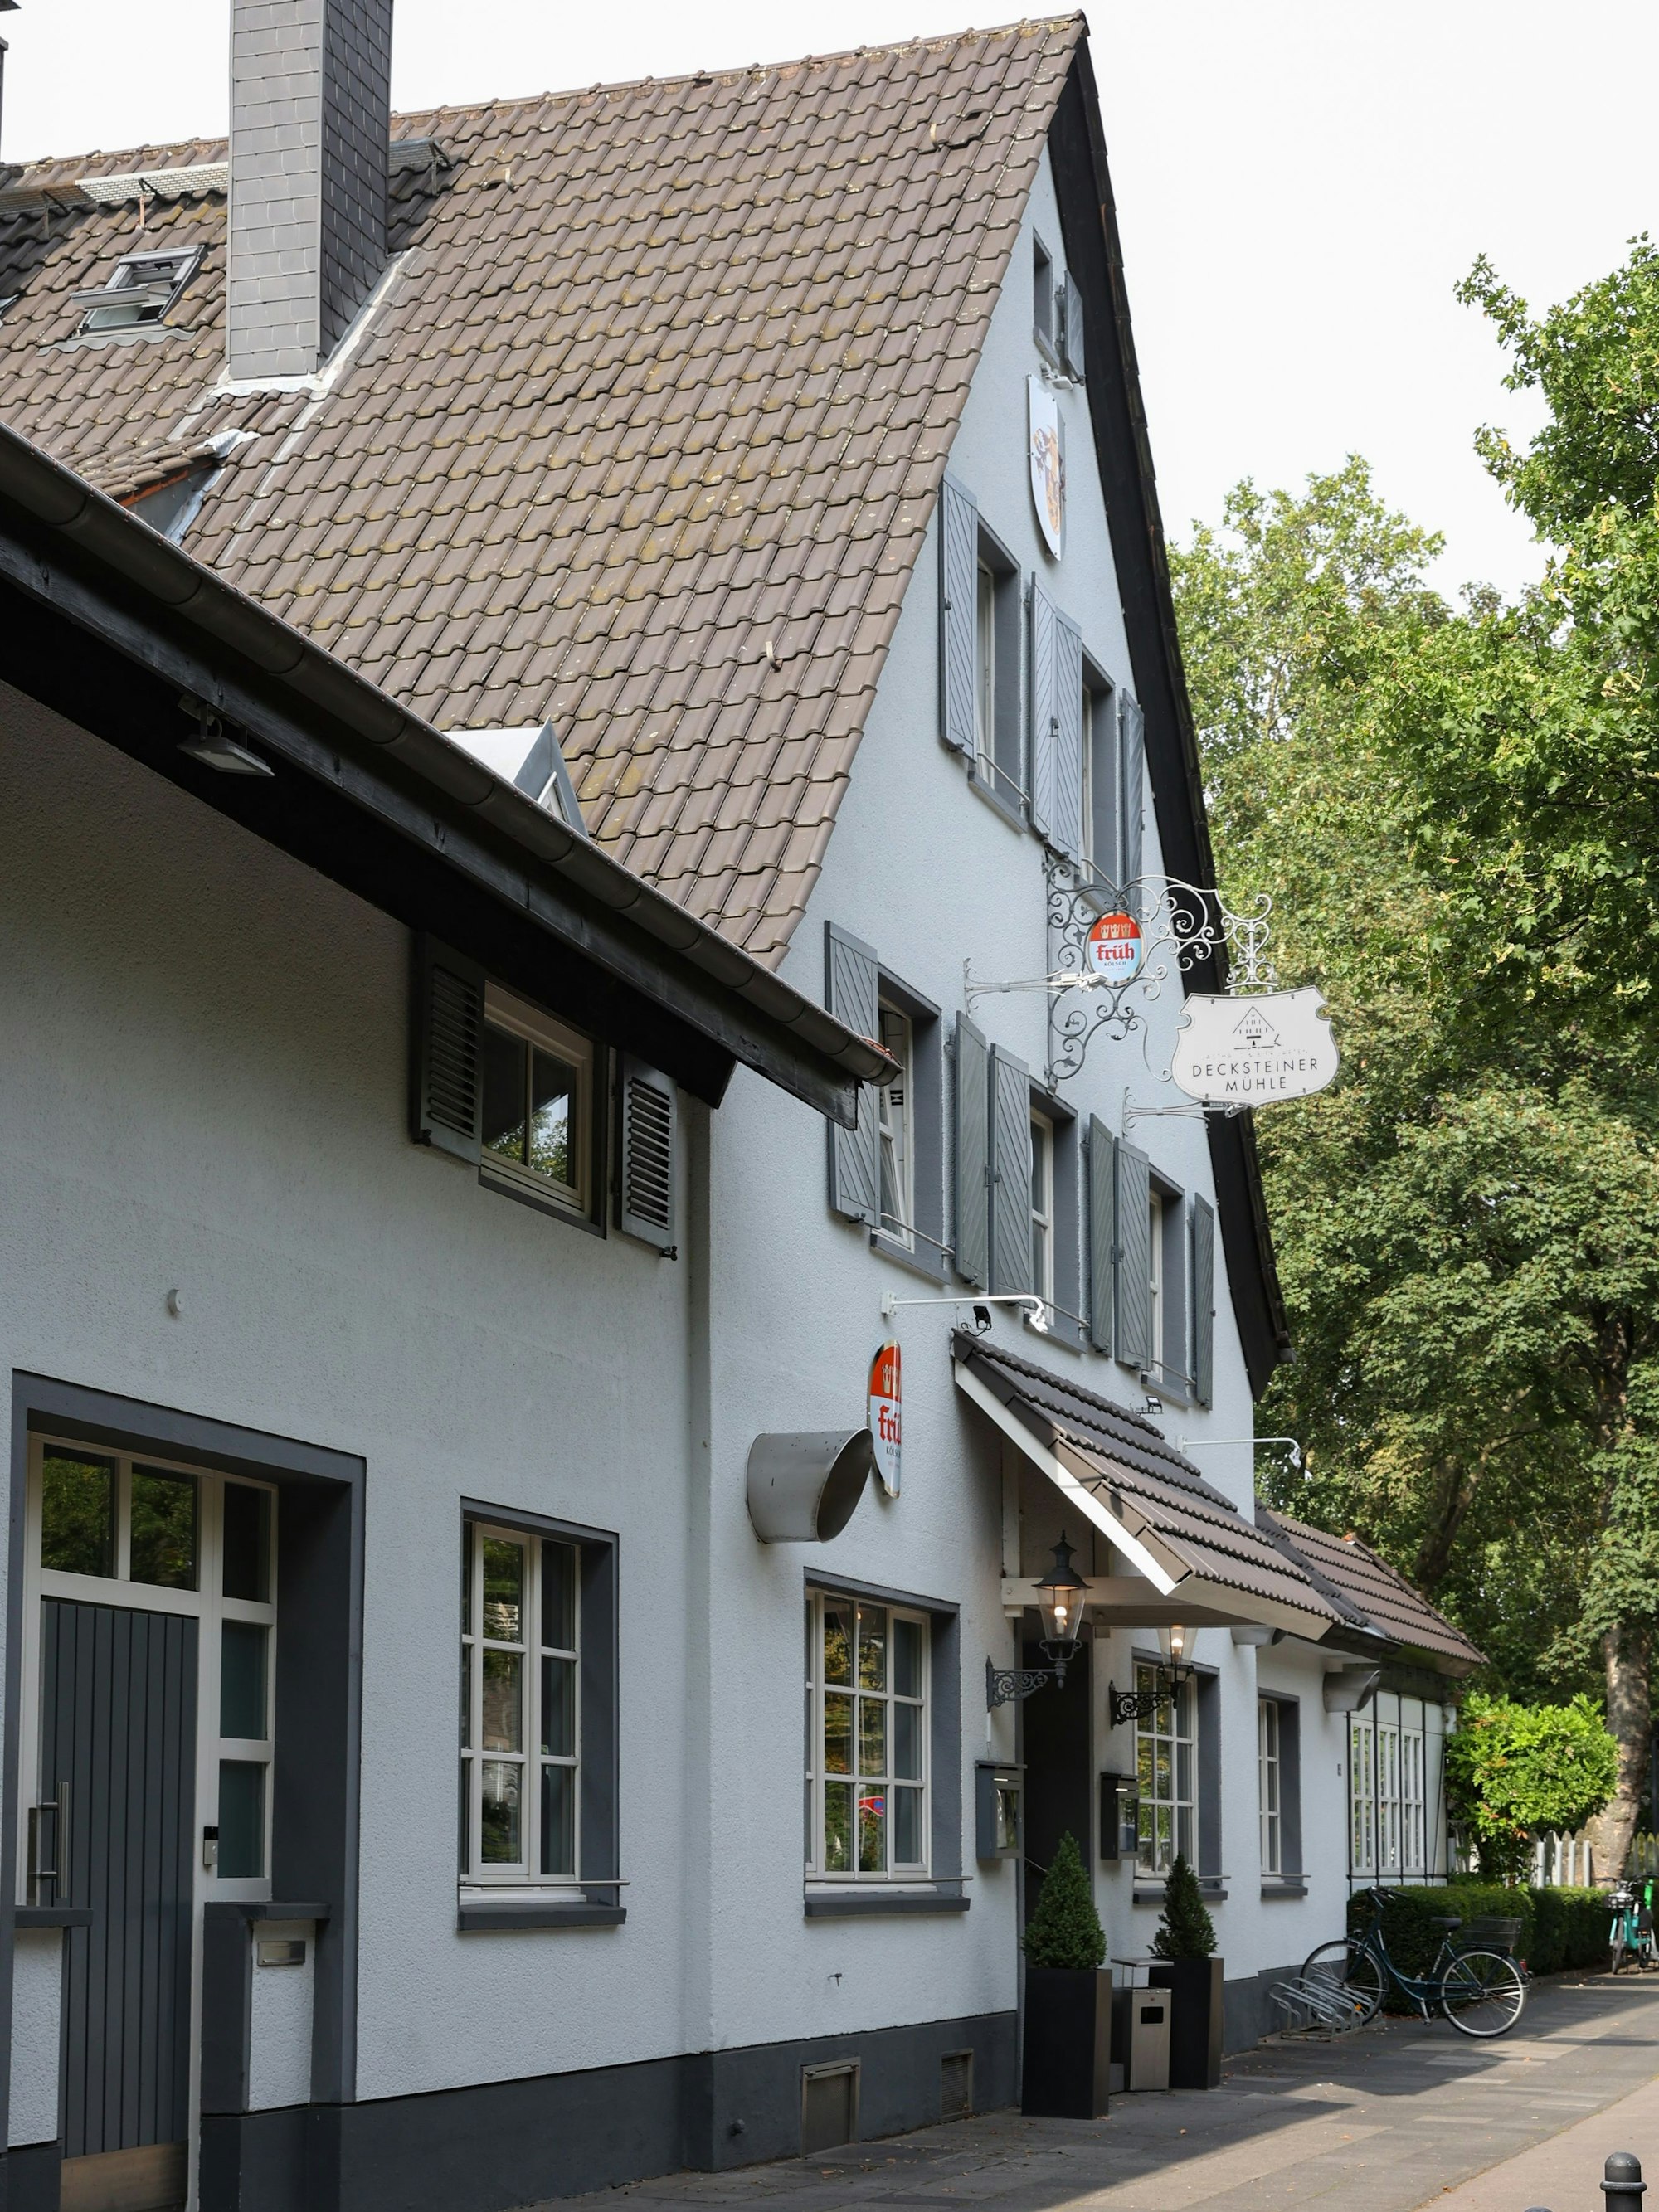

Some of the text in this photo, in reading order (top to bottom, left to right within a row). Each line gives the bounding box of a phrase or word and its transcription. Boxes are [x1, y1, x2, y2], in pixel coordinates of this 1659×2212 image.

[1096, 942, 1135, 961] früh
[1193, 1058, 1317, 1077] DECKSTEINER
[1225, 1076, 1287, 1091] MÜHLE
[878, 1405, 901, 1445] frü
